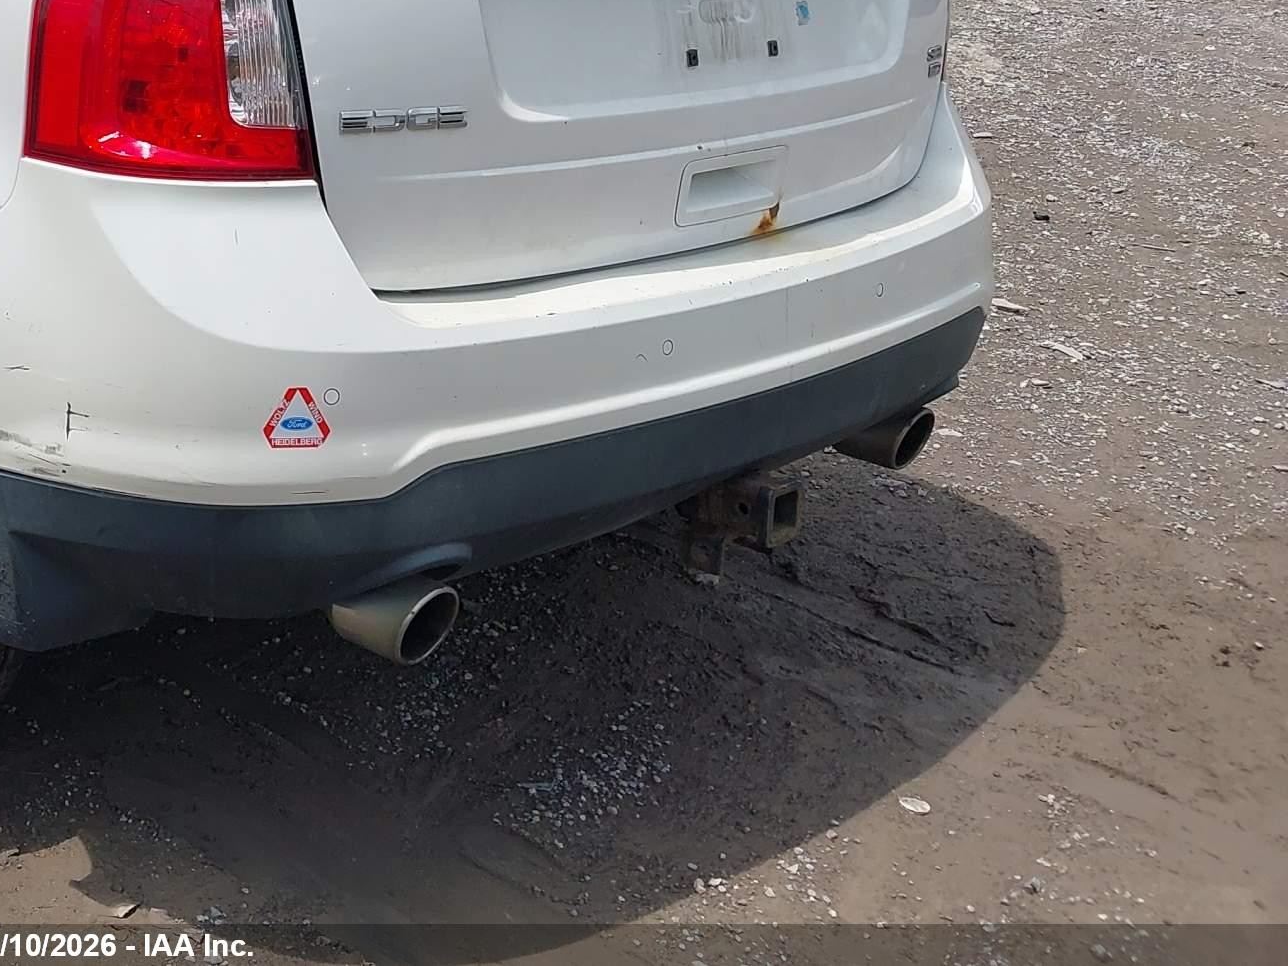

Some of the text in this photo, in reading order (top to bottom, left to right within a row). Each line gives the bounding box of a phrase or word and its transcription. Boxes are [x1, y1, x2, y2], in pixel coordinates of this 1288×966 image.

[339, 105, 469, 135] EDGE
[269, 399, 290, 427] WOLTZ
[286, 419, 308, 428] Ford
[308, 401, 323, 424] WIND
[272, 438, 323, 446] HEIDELBERG
